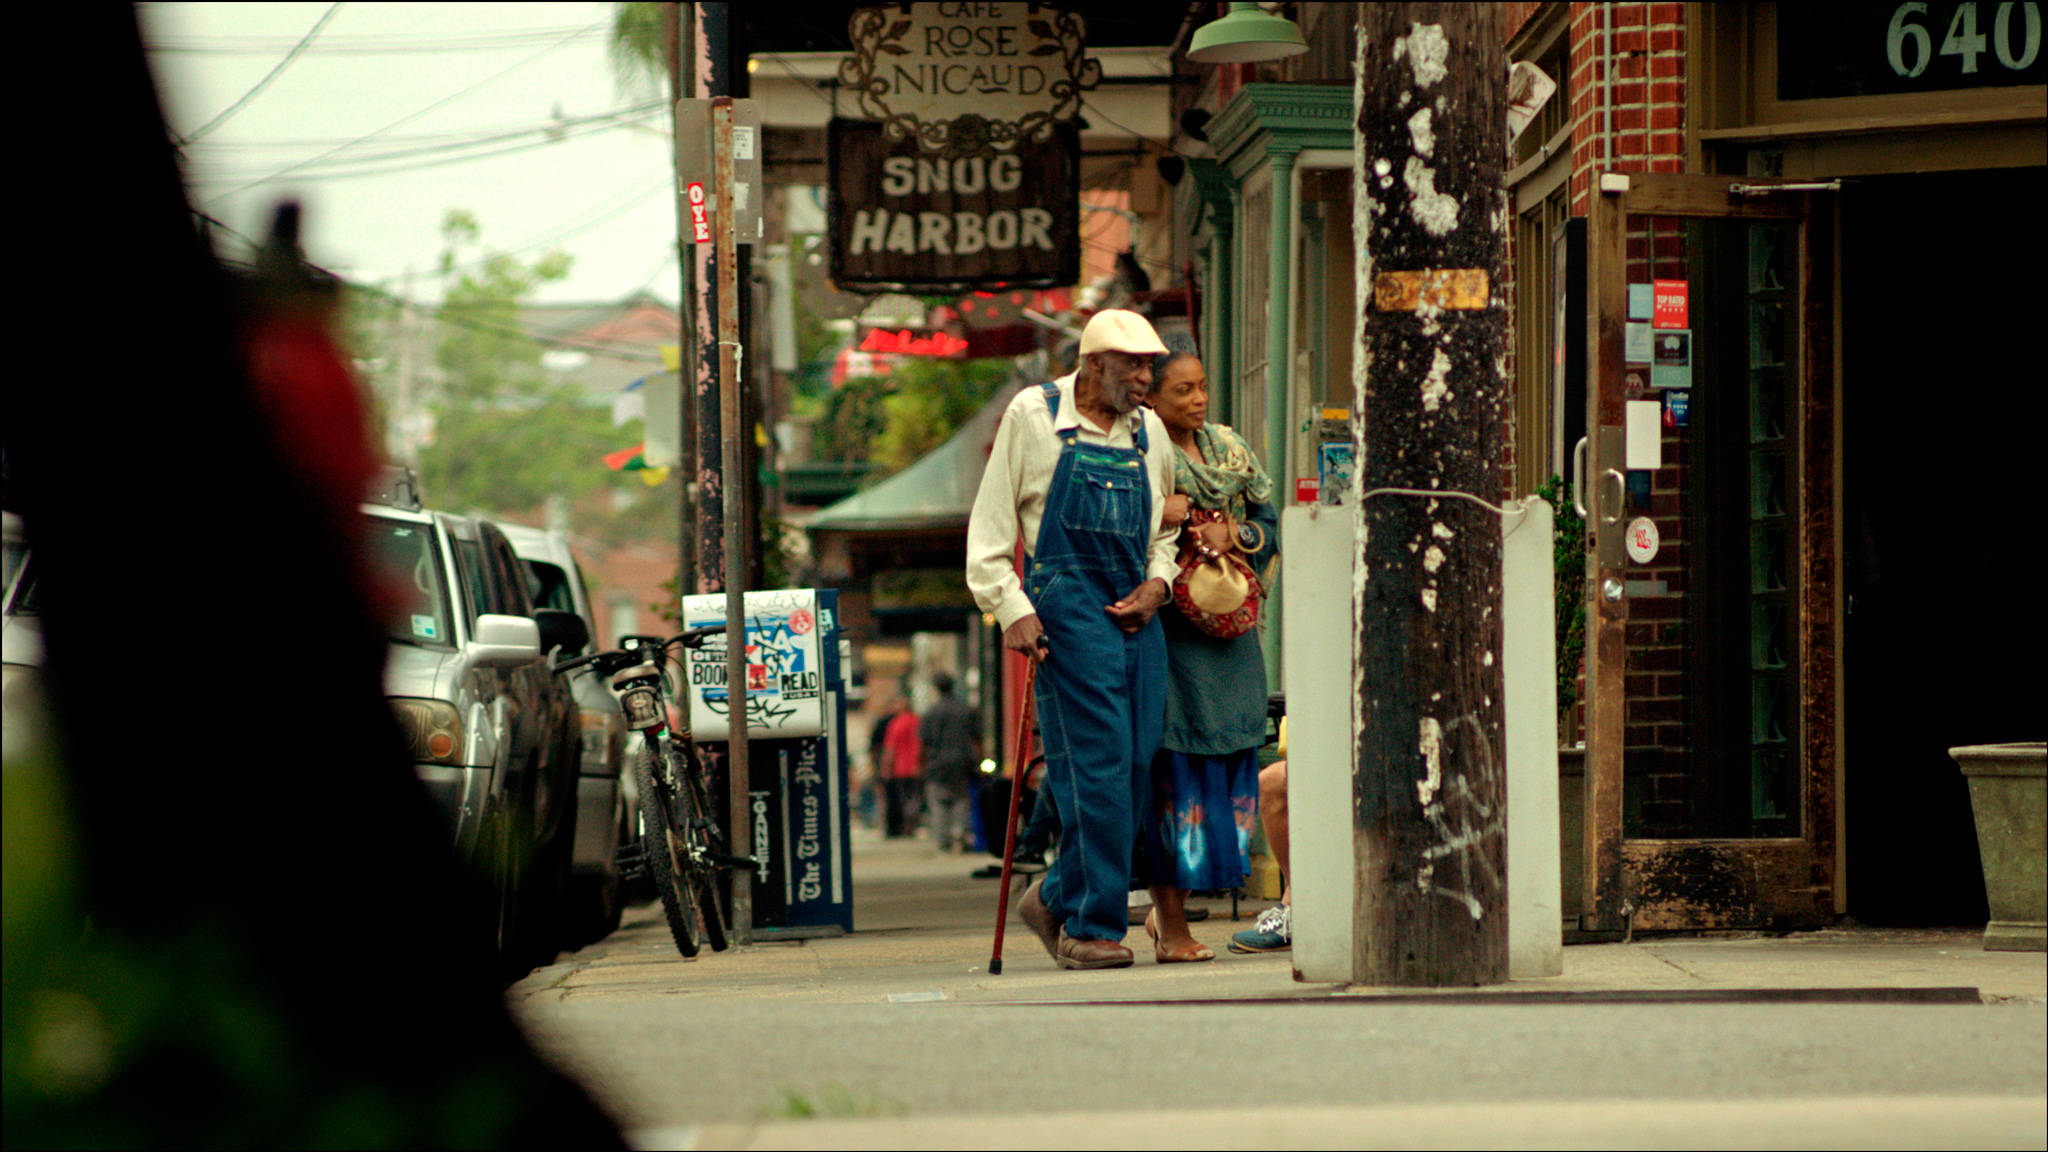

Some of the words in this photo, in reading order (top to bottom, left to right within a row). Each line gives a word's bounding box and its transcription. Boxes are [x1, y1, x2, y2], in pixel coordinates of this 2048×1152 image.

[924, 25, 1018, 56] ROSE
[1886, 2, 2042, 78] 640
[892, 63, 1046, 95] NICAUD
[881, 154, 1023, 197] SNUG
[689, 184, 710, 241] OYE
[850, 207, 1055, 256] HARBOR
[781, 671, 818, 692] READ
[798, 861, 822, 903] The
